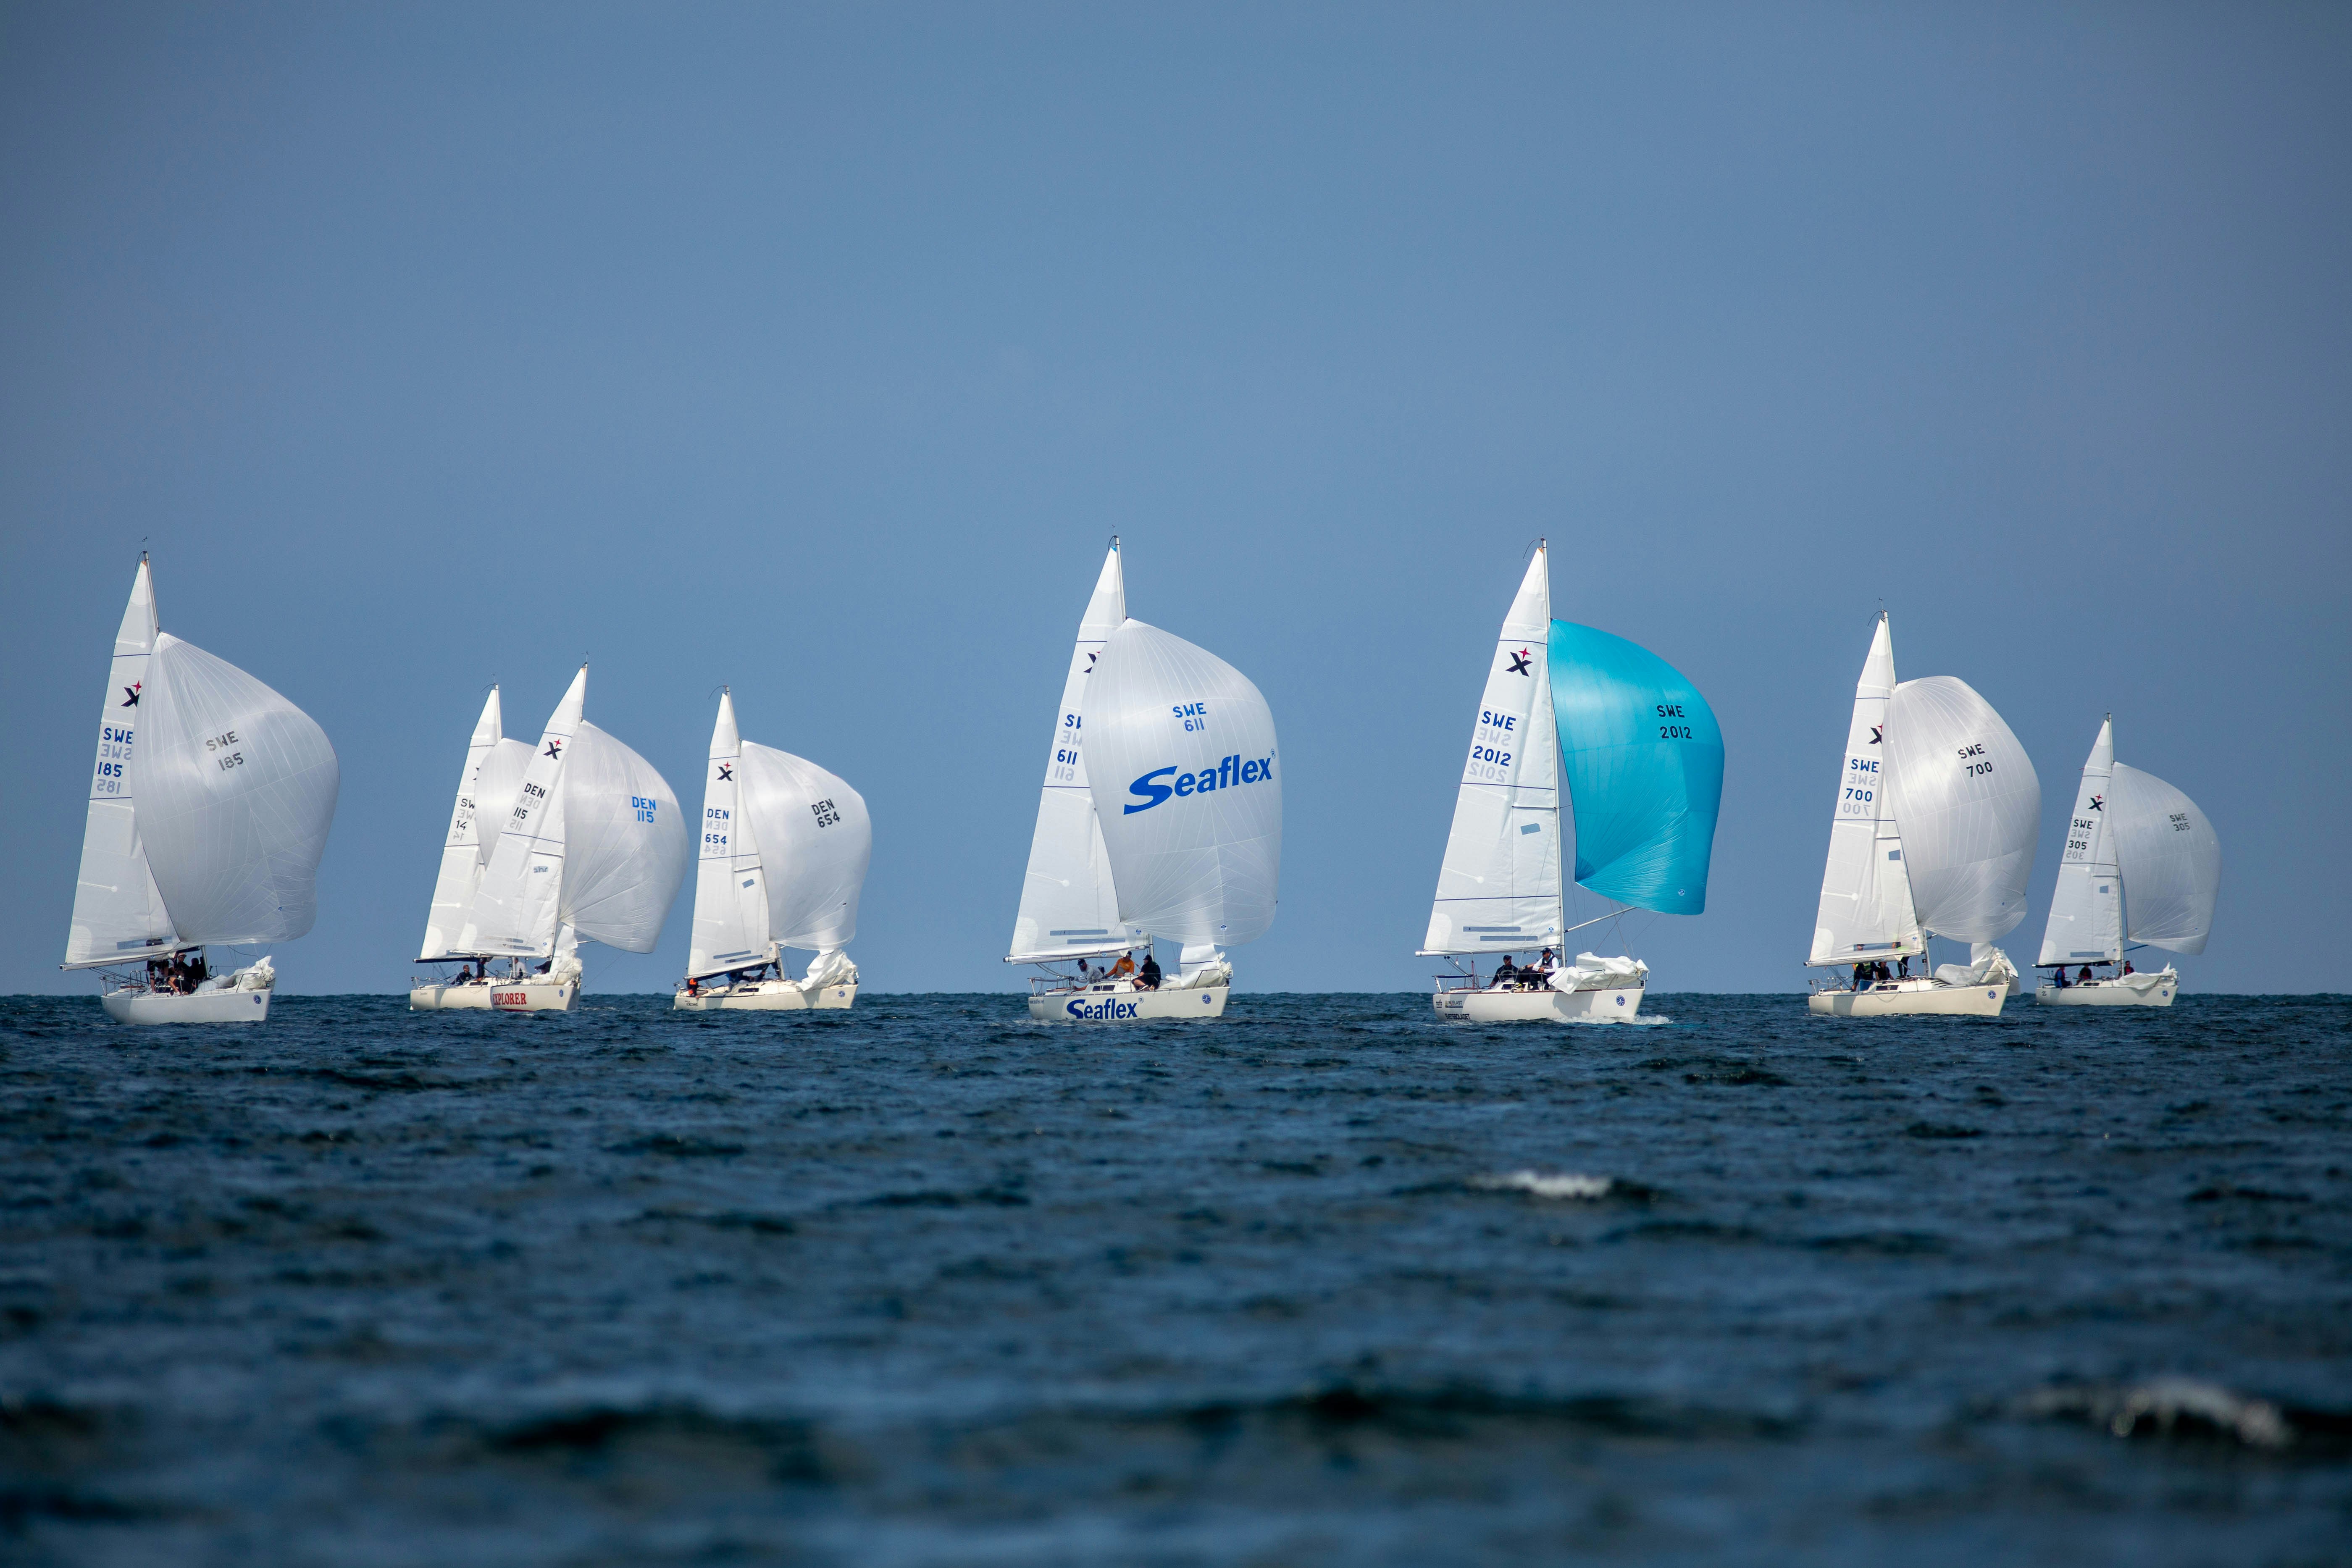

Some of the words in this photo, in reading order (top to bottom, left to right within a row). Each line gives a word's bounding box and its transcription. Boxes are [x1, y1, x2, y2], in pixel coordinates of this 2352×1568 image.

[1172, 702, 1207, 718] SWE
[1656, 705, 1685, 718] SWE
[1184, 718, 1205, 732] 611
[1481, 711, 1516, 731] SWE
[103, 728, 133, 744] SWE
[1659, 726, 1692, 739] 2012
[205, 731, 238, 751] SWE
[1057, 749, 1077, 765] 611
[1472, 745, 1511, 767] 2012
[1958, 743, 1985, 759] SWE
[218, 753, 243, 771] 185
[1851, 759, 1879, 773] SWE
[97, 762, 123, 777] 185
[1966, 762, 1993, 777] 700
[524, 783, 545, 798] DEN
[1845, 788, 1872, 802] 700
[461, 798, 475, 809] SW
[632, 796, 656, 811] DEN
[811, 798, 835, 816] DEN
[513, 806, 528, 819] 115
[637, 810, 654, 823] 115
[707, 809, 729, 820] DEN
[817, 811, 841, 828] 654
[2169, 813, 2187, 823] SWE
[456, 820, 467, 830] 14
[2073, 819, 2093, 830] SWE
[2173, 822, 2190, 831] 305
[705, 834, 727, 845] 654
[2068, 840, 2087, 850] 305
[493, 993, 527, 1005] EXPLORER
